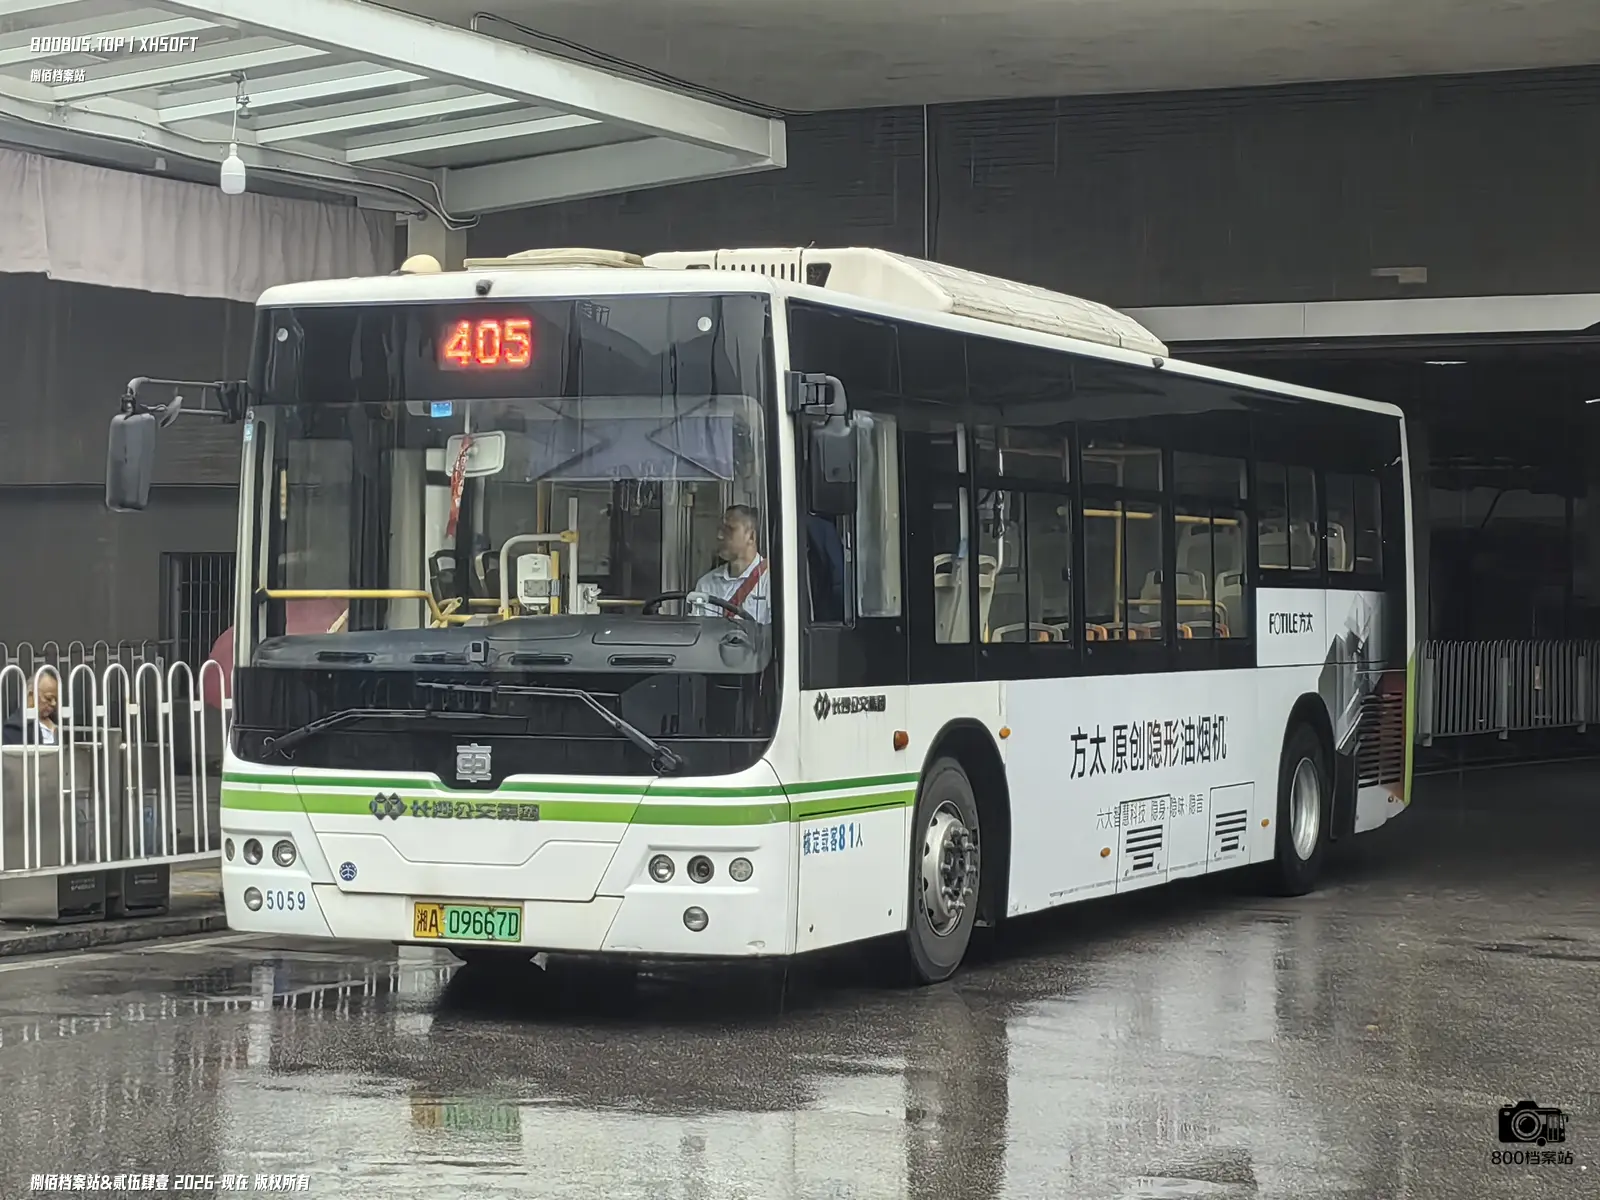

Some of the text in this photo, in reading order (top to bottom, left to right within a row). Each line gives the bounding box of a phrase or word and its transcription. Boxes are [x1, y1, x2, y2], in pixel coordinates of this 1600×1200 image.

[445, 319, 532, 366] 405
[1269, 612, 1298, 635] FOTILE
[266, 889, 306, 911] 5059
